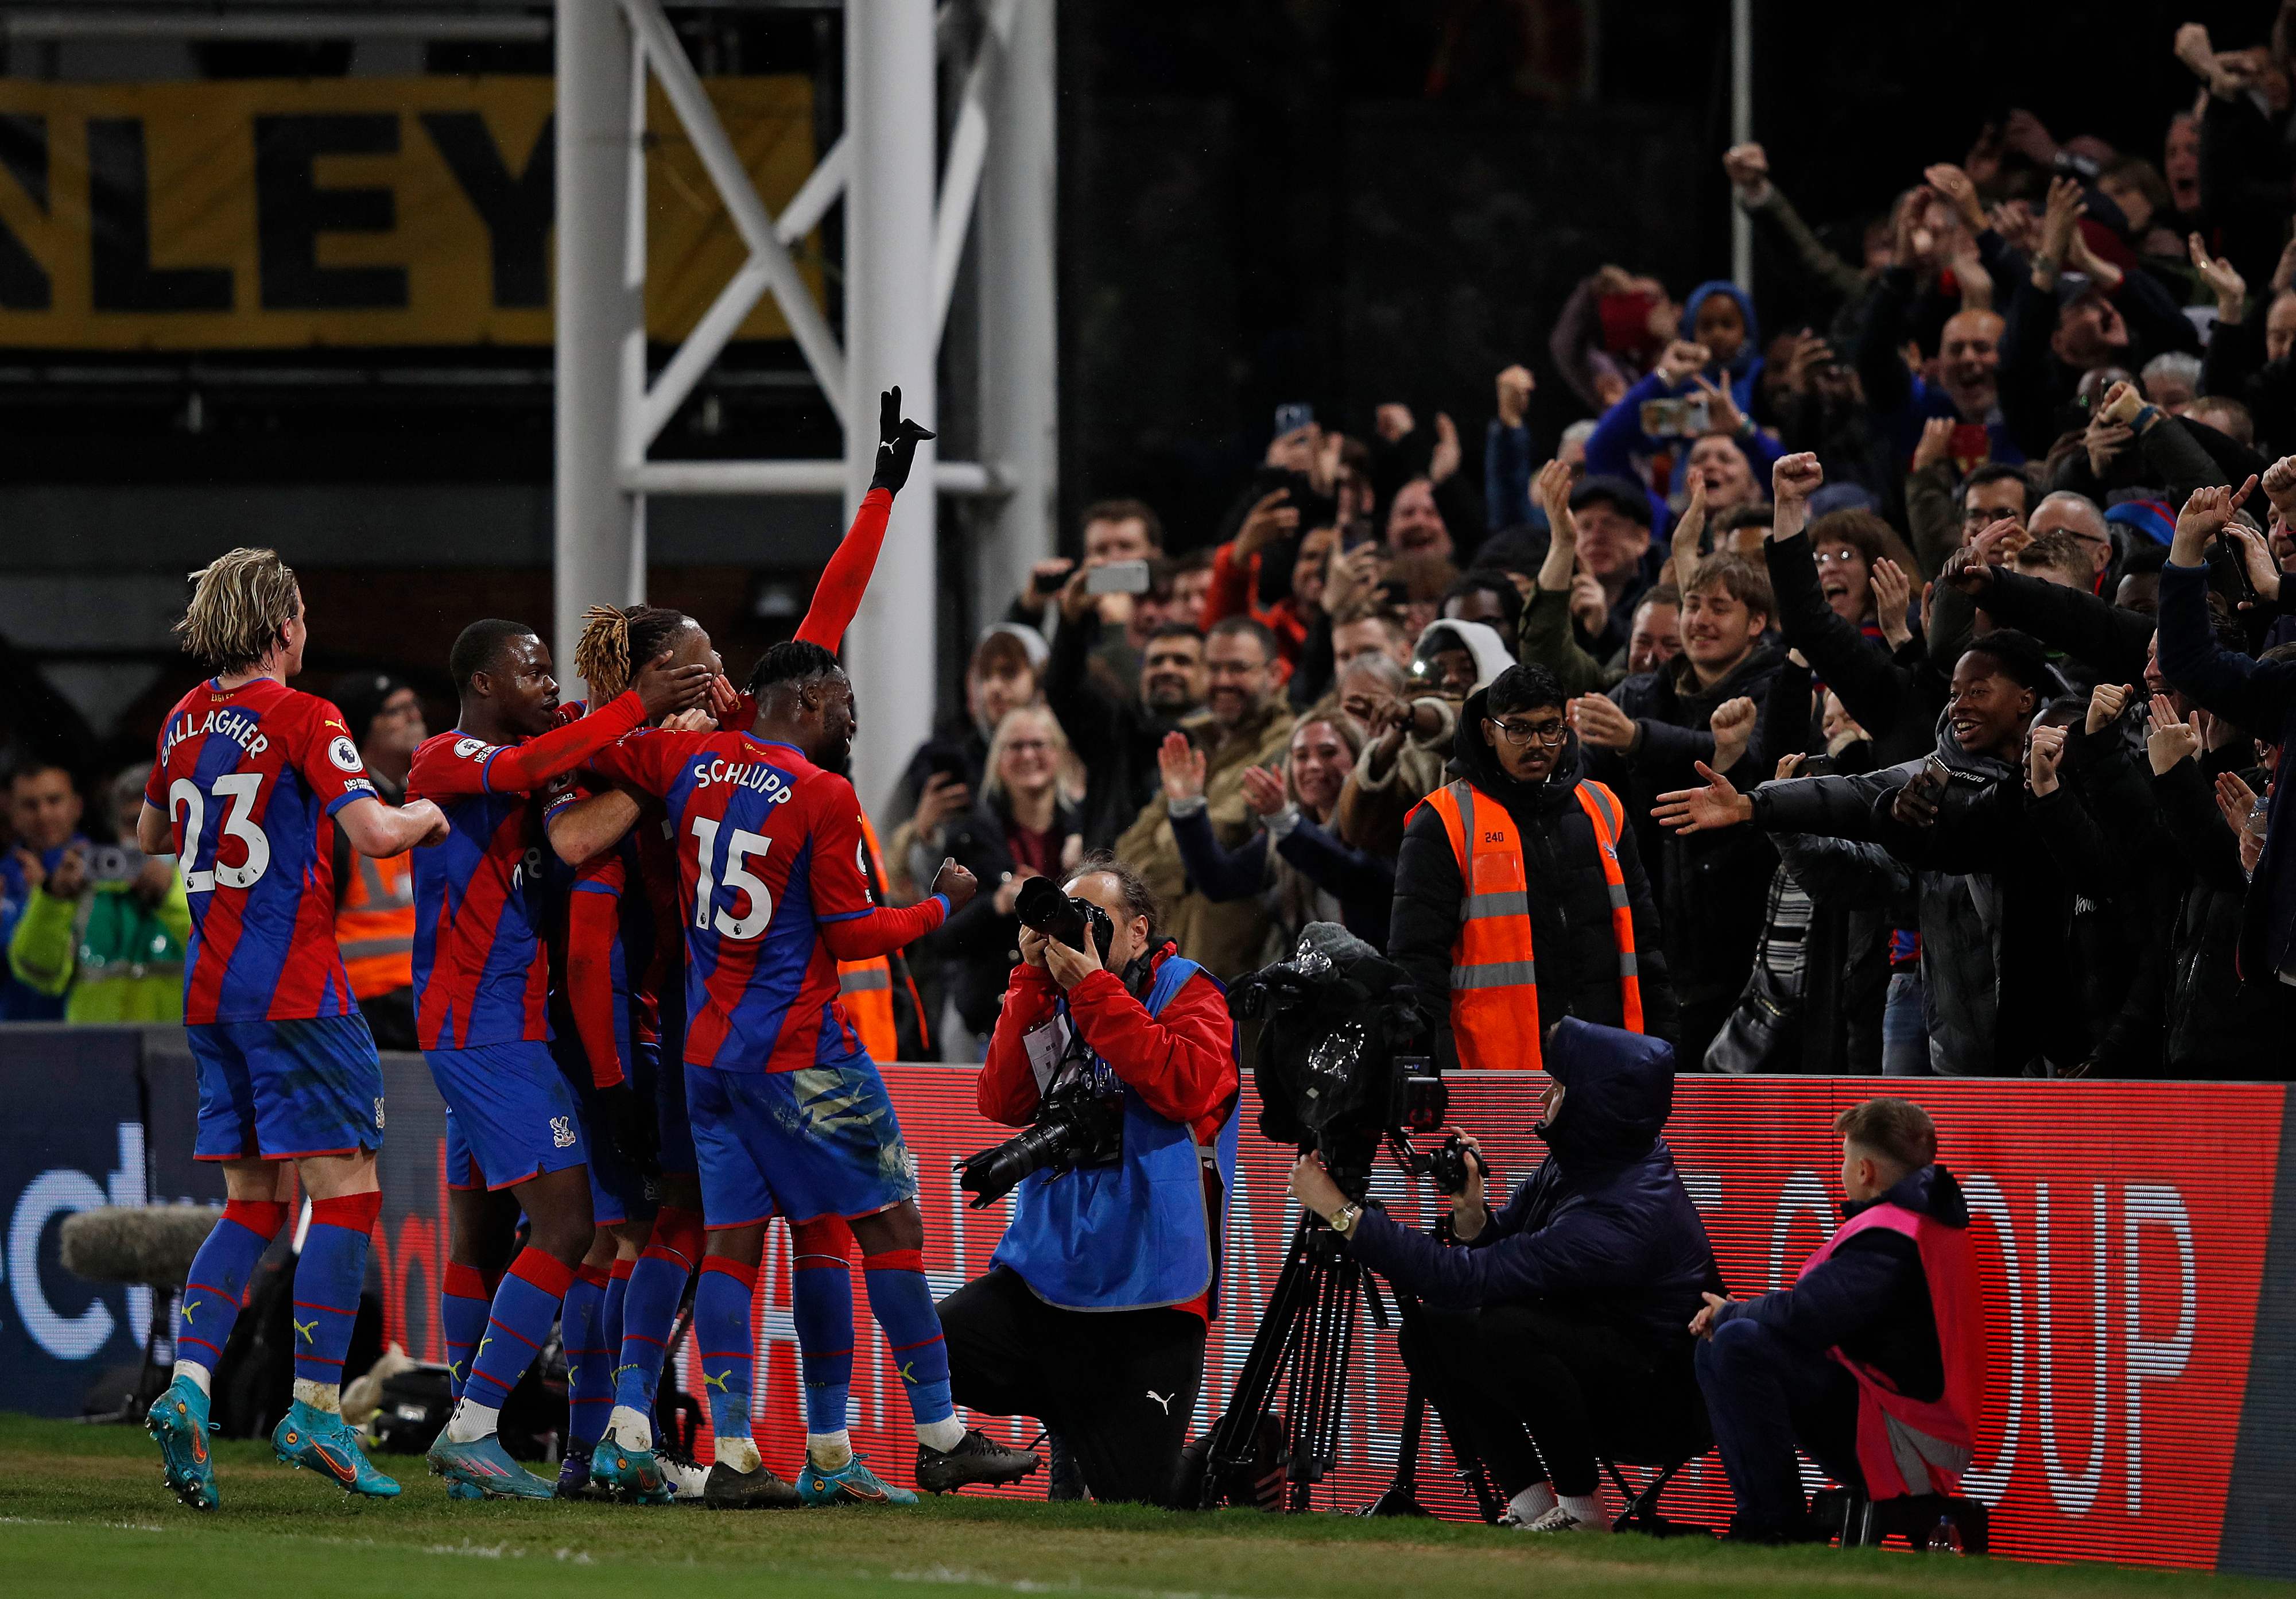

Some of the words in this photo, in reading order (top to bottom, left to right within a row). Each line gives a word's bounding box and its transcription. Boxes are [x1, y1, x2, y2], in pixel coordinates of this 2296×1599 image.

[162, 710, 268, 767] GALLAGHER
[344, 779, 356, 788] No
[694, 759, 792, 804] SCHLUPP
[170, 773, 270, 893] 23
[1485, 831, 1504, 843] 240
[692, 816, 773, 939] 15
